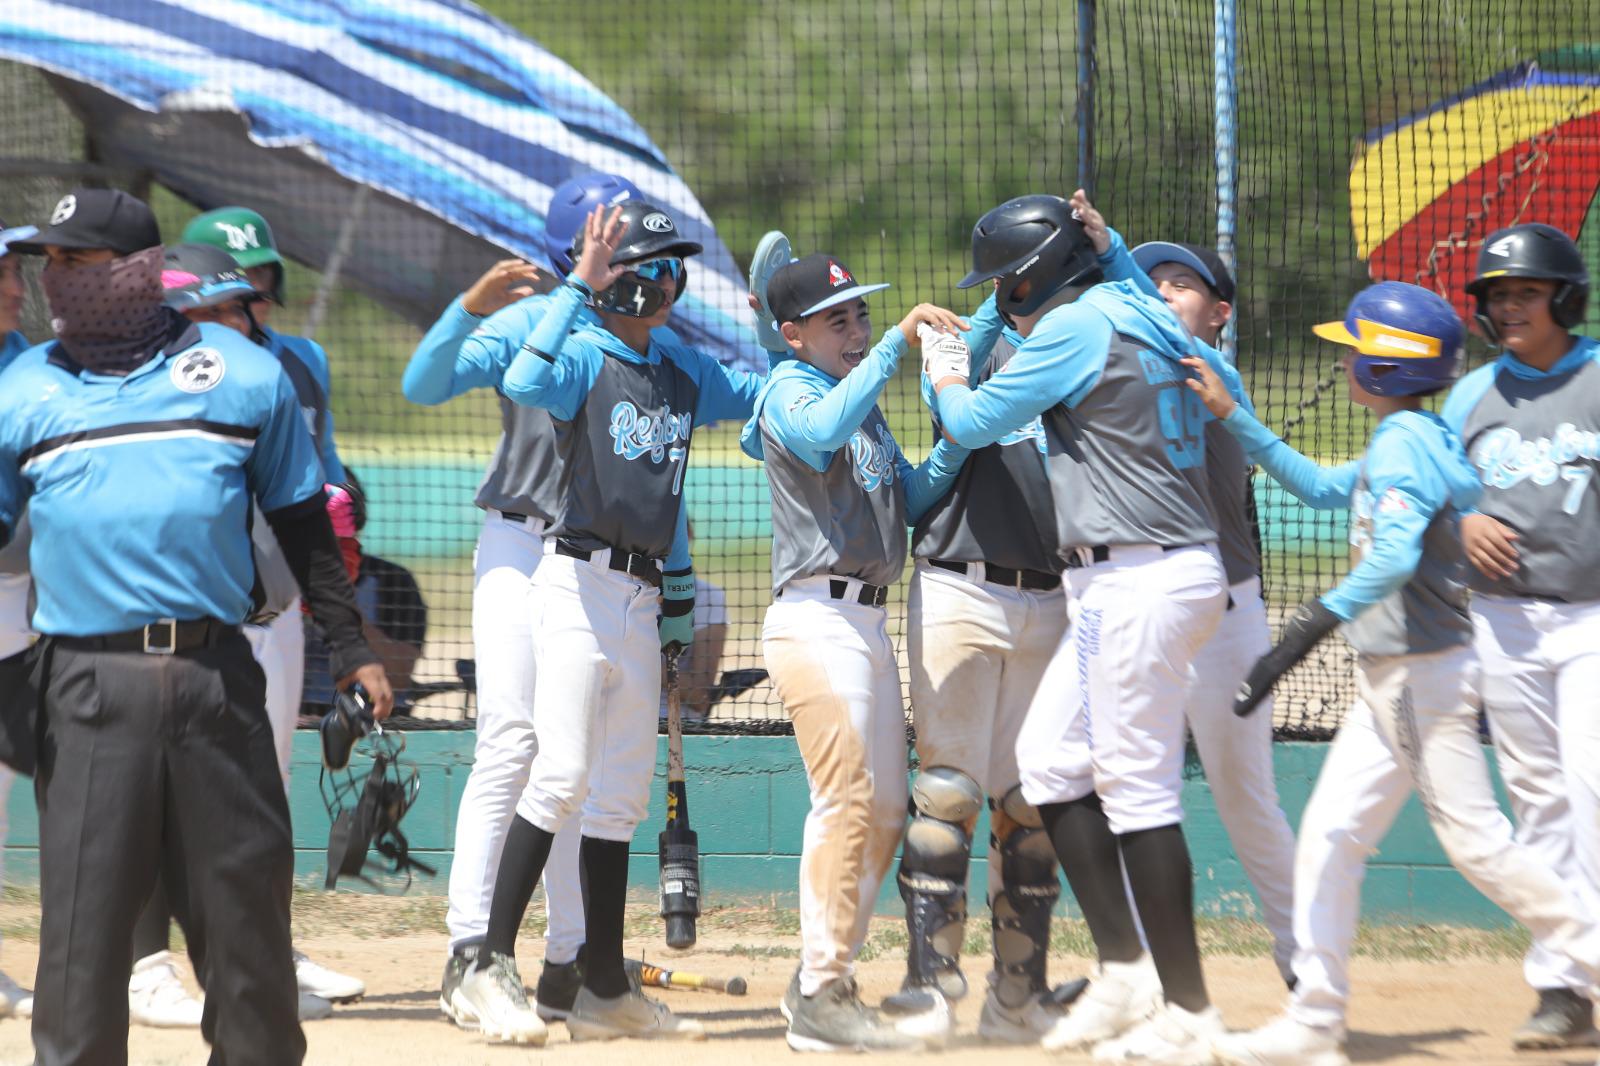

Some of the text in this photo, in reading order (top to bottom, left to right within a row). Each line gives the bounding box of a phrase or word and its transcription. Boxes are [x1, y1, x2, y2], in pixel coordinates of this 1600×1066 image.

[609, 401, 691, 464] Region
[1157, 387, 1206, 469] 99
[668, 446, 687, 496] 7
[1560, 463, 1593, 516] 7
